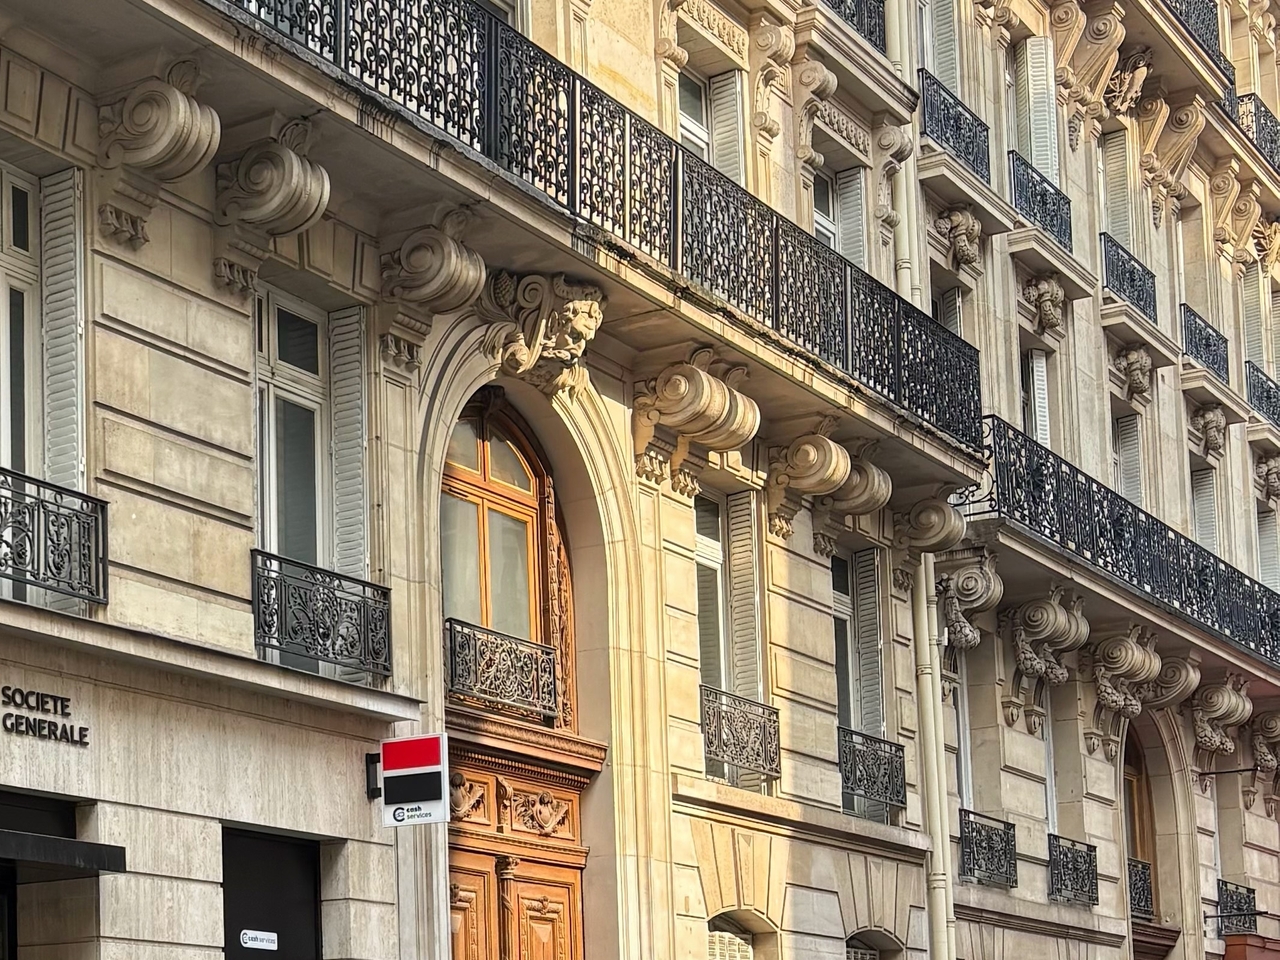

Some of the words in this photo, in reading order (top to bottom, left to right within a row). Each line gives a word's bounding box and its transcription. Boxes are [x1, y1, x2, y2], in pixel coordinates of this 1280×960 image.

[1, 685, 72, 717] SOCIETE
[2, 712, 90, 746] GENERALE
[406, 805, 422, 813] cash
[406, 812, 432, 820] services
